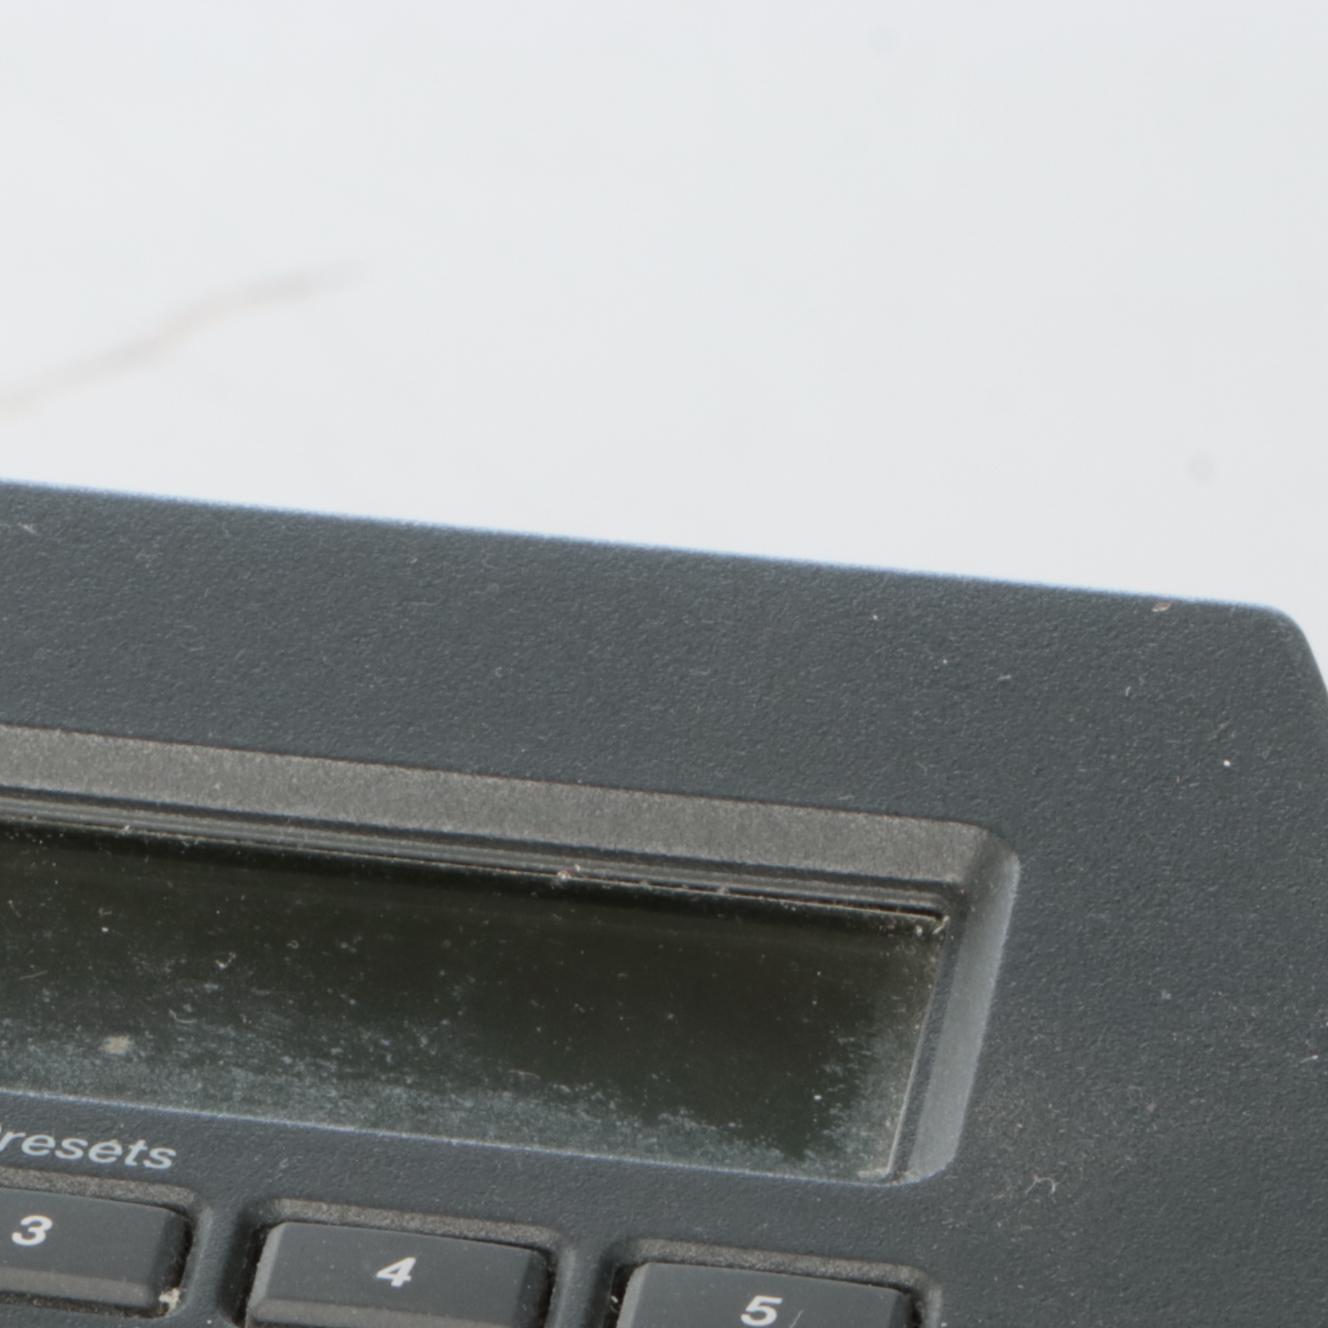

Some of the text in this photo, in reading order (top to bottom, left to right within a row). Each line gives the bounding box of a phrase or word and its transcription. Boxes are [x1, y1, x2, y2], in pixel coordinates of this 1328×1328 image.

[10, 1214, 53, 1247] 3
[375, 1255, 418, 1288] 4
[739, 1295, 784, 1328] 5
